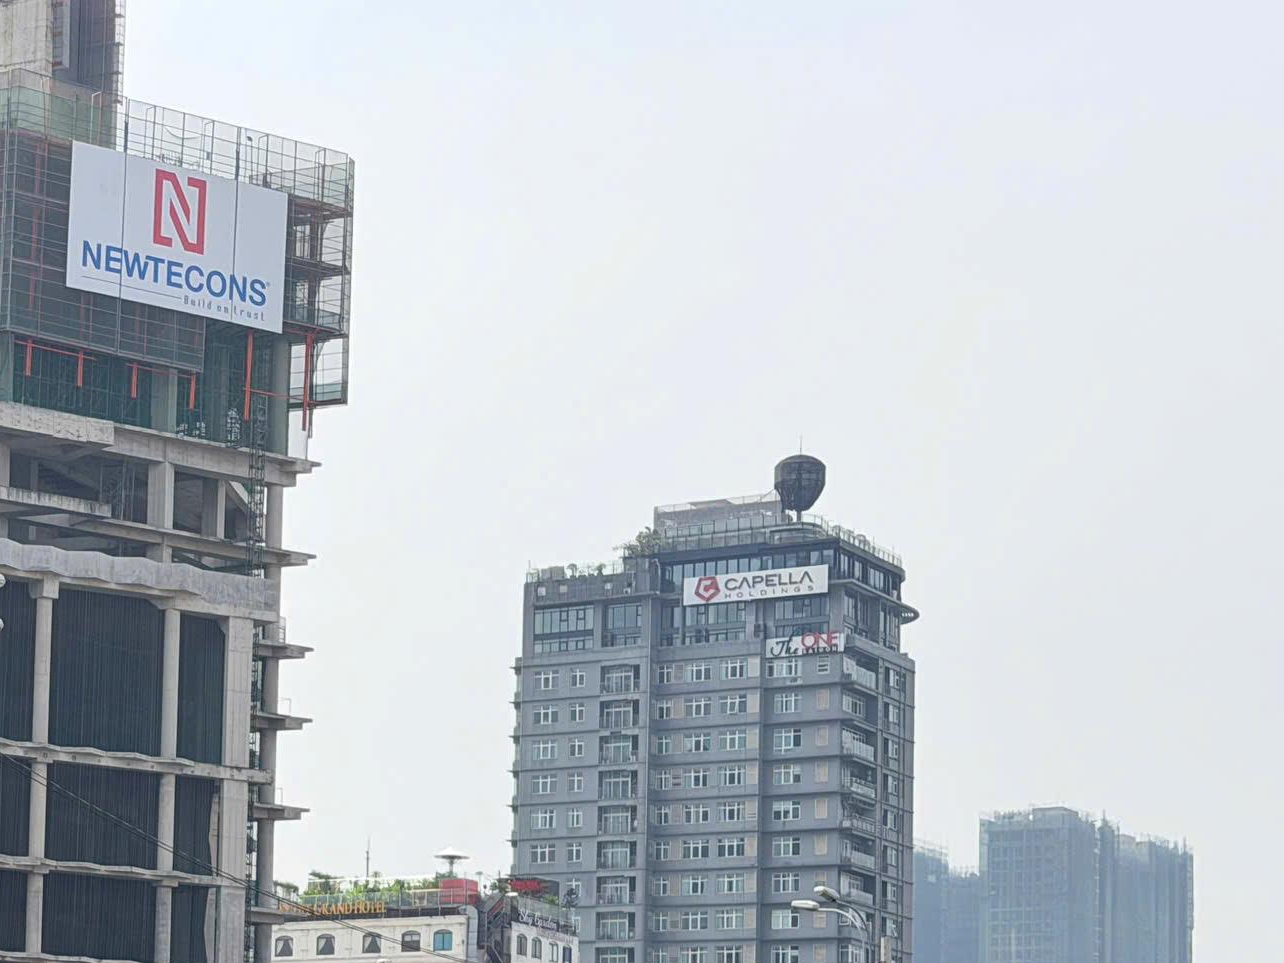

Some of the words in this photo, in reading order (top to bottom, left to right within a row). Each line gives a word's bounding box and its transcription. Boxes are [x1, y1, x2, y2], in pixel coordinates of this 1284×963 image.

[81, 239, 267, 307] NEWTECONS
[183, 294, 213, 310] Build
[216, 305, 229, 315] on
[233, 306, 266, 322] trust
[724, 570, 814, 591] CAPELLA
[724, 585, 814, 599] HOLDINGS
